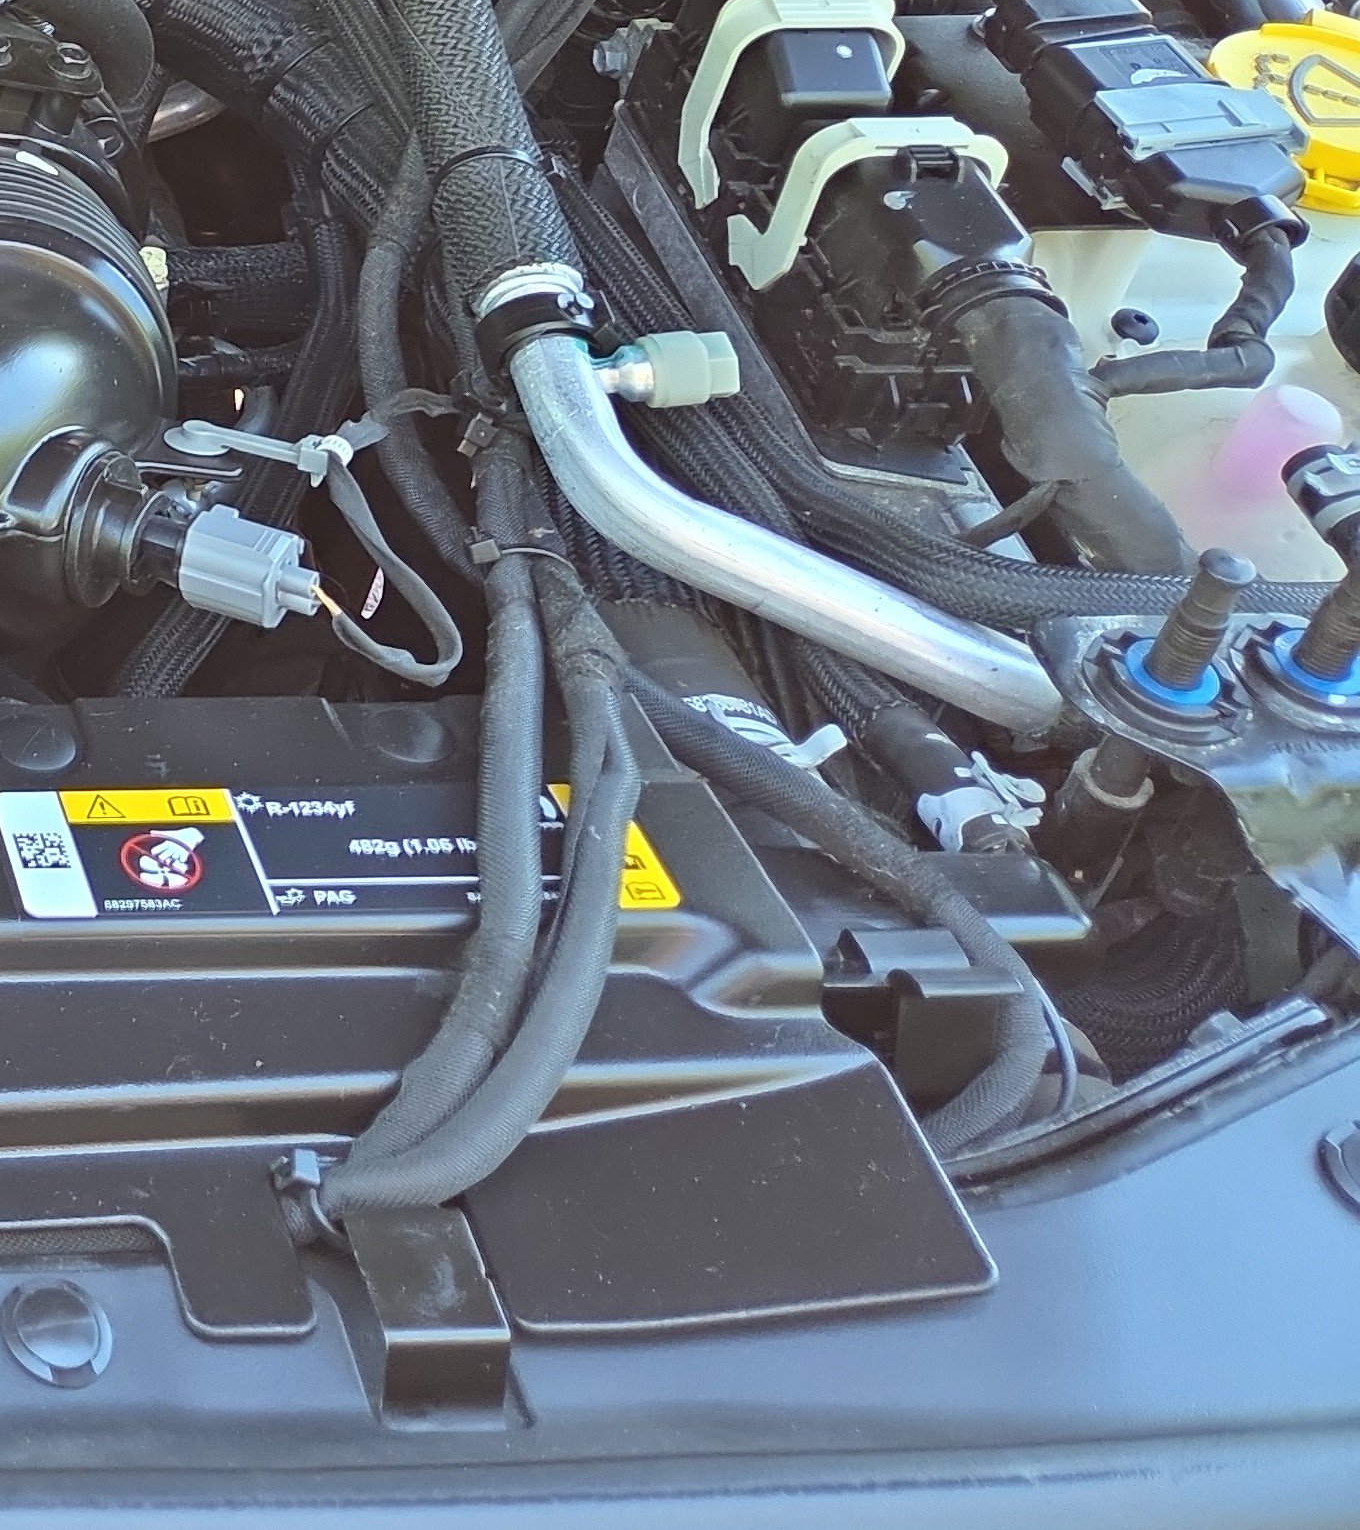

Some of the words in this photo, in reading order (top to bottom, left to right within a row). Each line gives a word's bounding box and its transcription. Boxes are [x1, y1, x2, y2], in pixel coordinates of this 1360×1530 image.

[265, 800, 357, 820] R-1234yf
[348, 838, 401, 858] 482g
[313, 888, 358, 906] PAG
